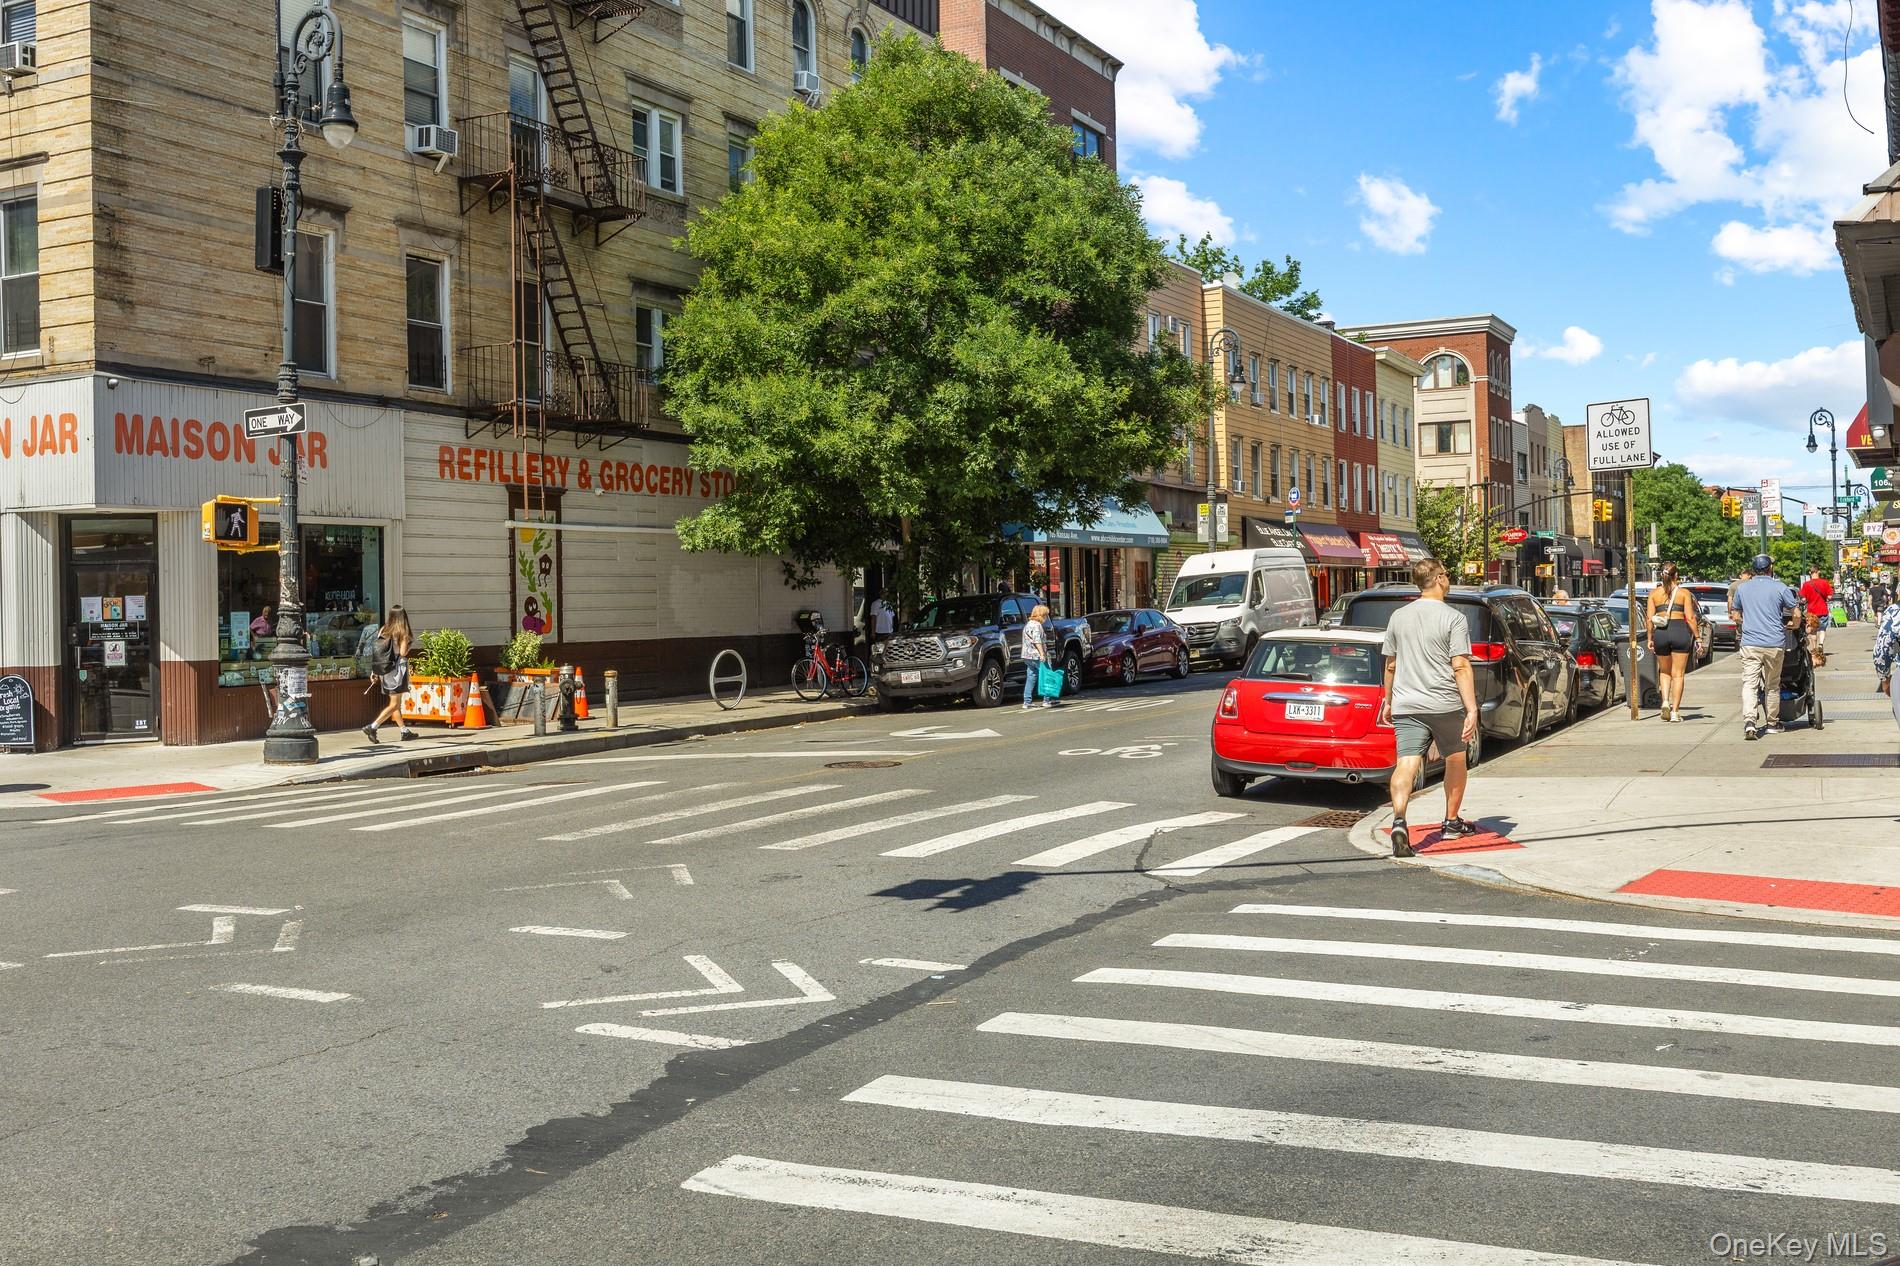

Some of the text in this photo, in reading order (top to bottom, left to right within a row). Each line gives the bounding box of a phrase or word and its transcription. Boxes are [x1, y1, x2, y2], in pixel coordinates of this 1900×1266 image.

[251, 413, 294, 429] ONE WAY
[23, 413, 78, 457] JAR
[114, 412, 256, 464] MAISON
[1596, 427, 1640, 439] ALLOWED
[1602, 440, 1636, 451] USE OF
[1593, 453, 1646, 465] FULL LANE
[438, 446, 570, 488] REFILLERY
[578, 458, 592, 489] &
[599, 460, 694, 497] GROCERY
